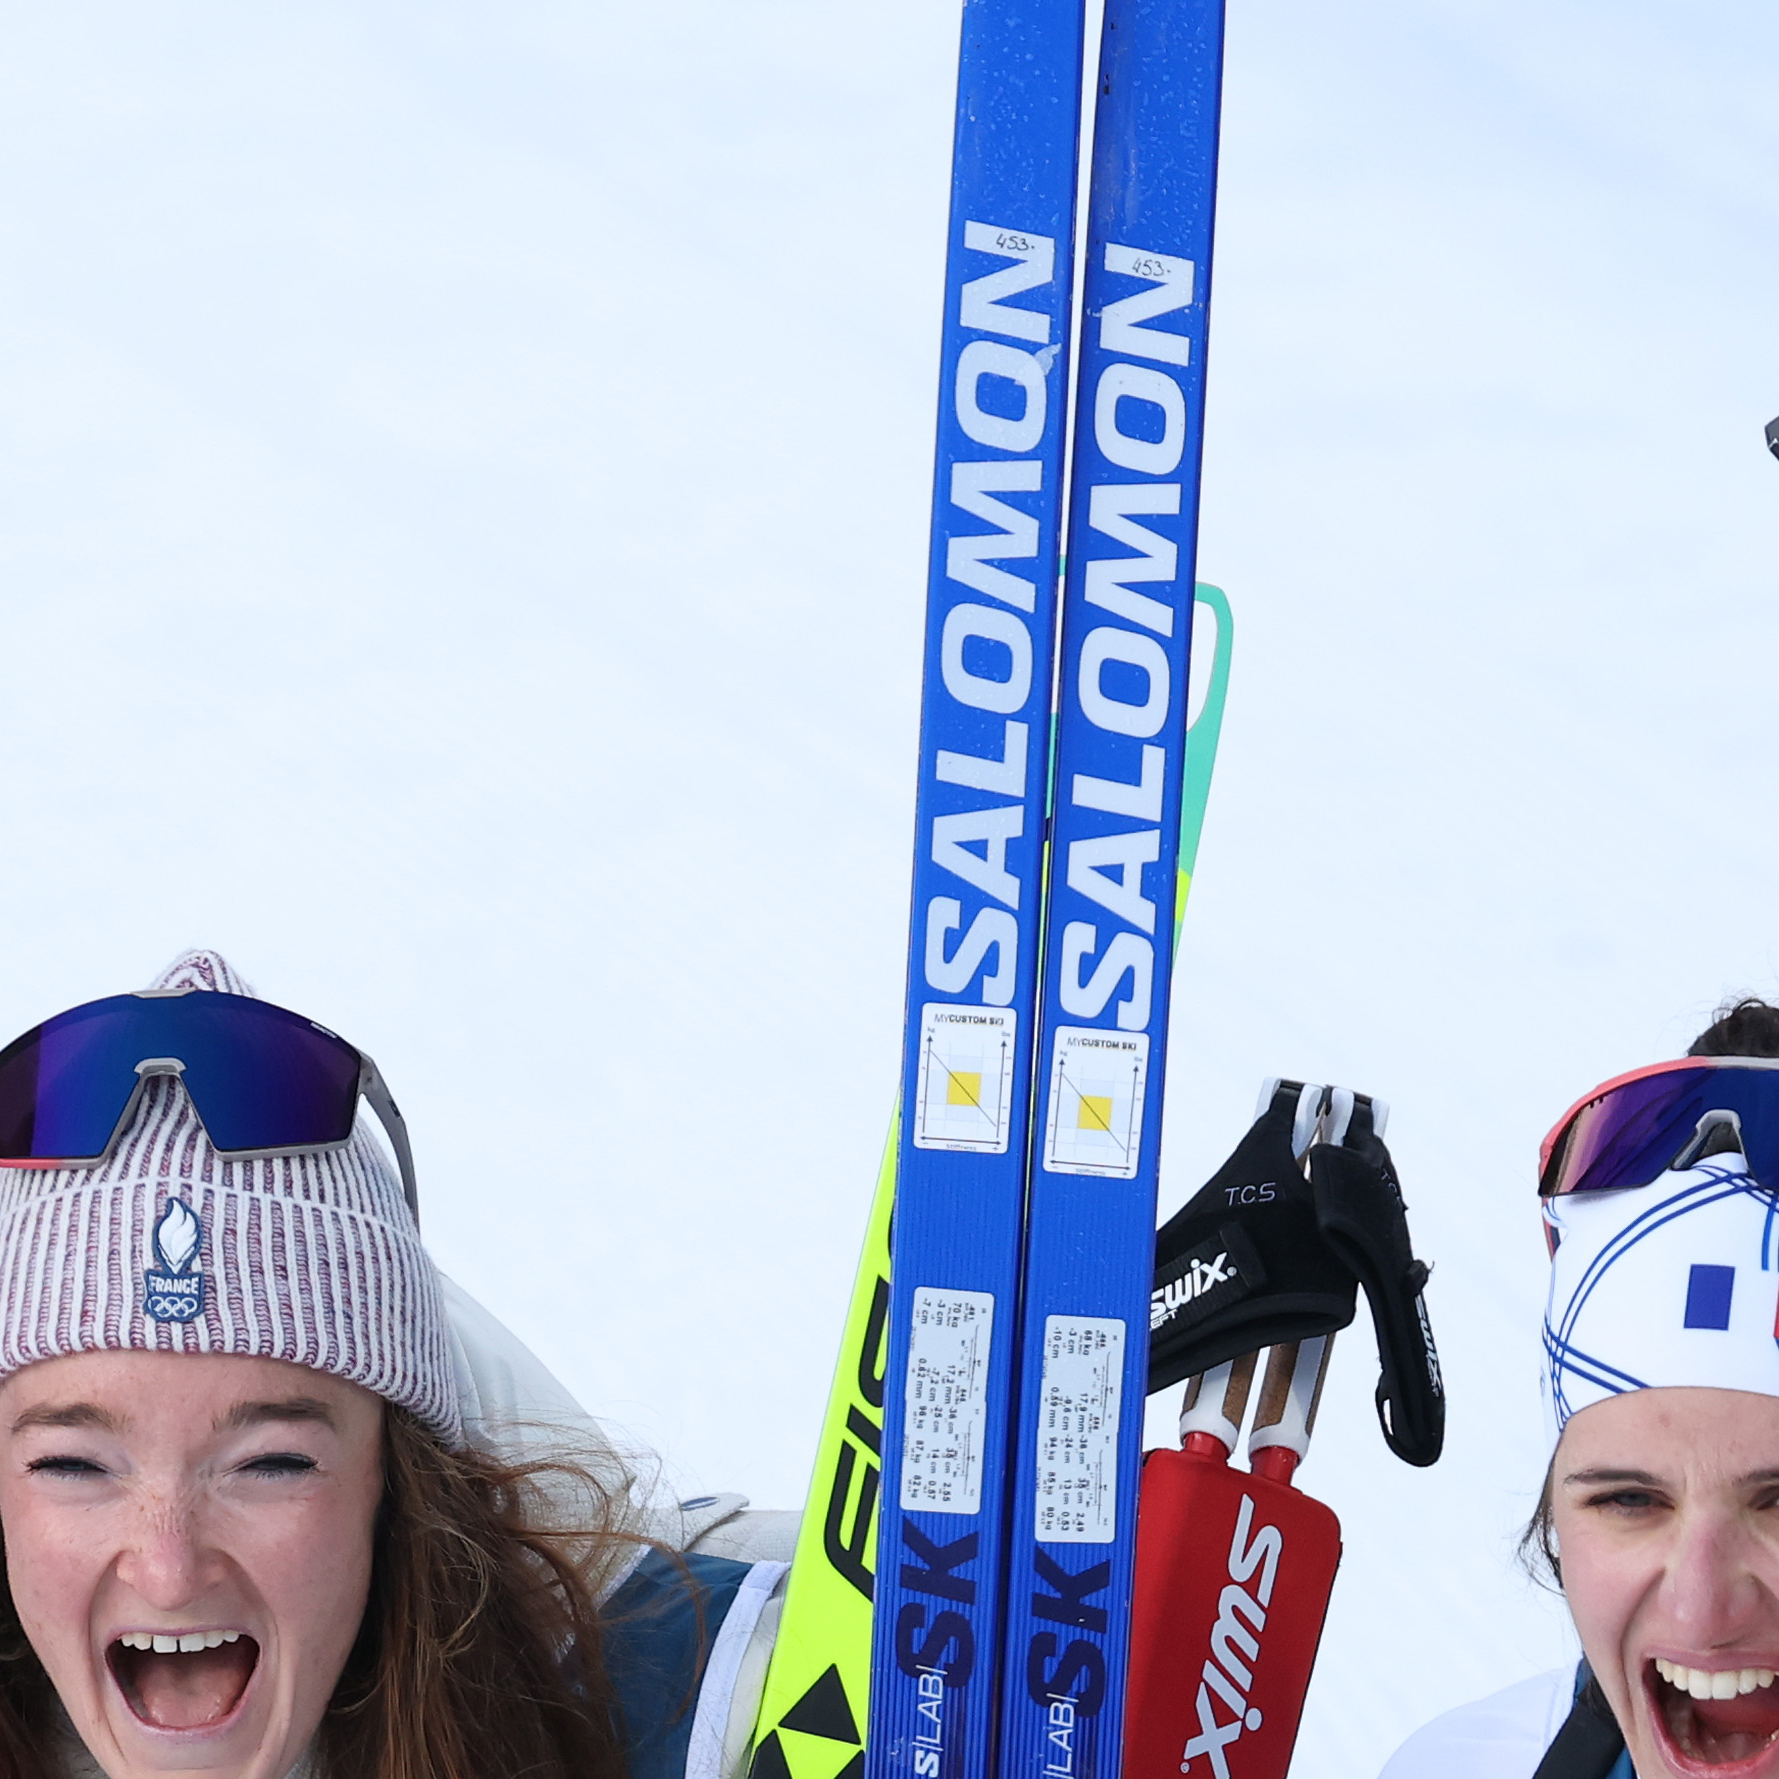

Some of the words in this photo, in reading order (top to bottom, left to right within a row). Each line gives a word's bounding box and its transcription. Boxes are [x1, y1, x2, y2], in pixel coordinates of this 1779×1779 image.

[924, 219, 1055, 1008] SALOMON
[1059, 242, 1195, 1031] SALOMON
[148, 1275, 200, 1295] FRANCE
[1149, 1311, 1178, 1333] EFT
